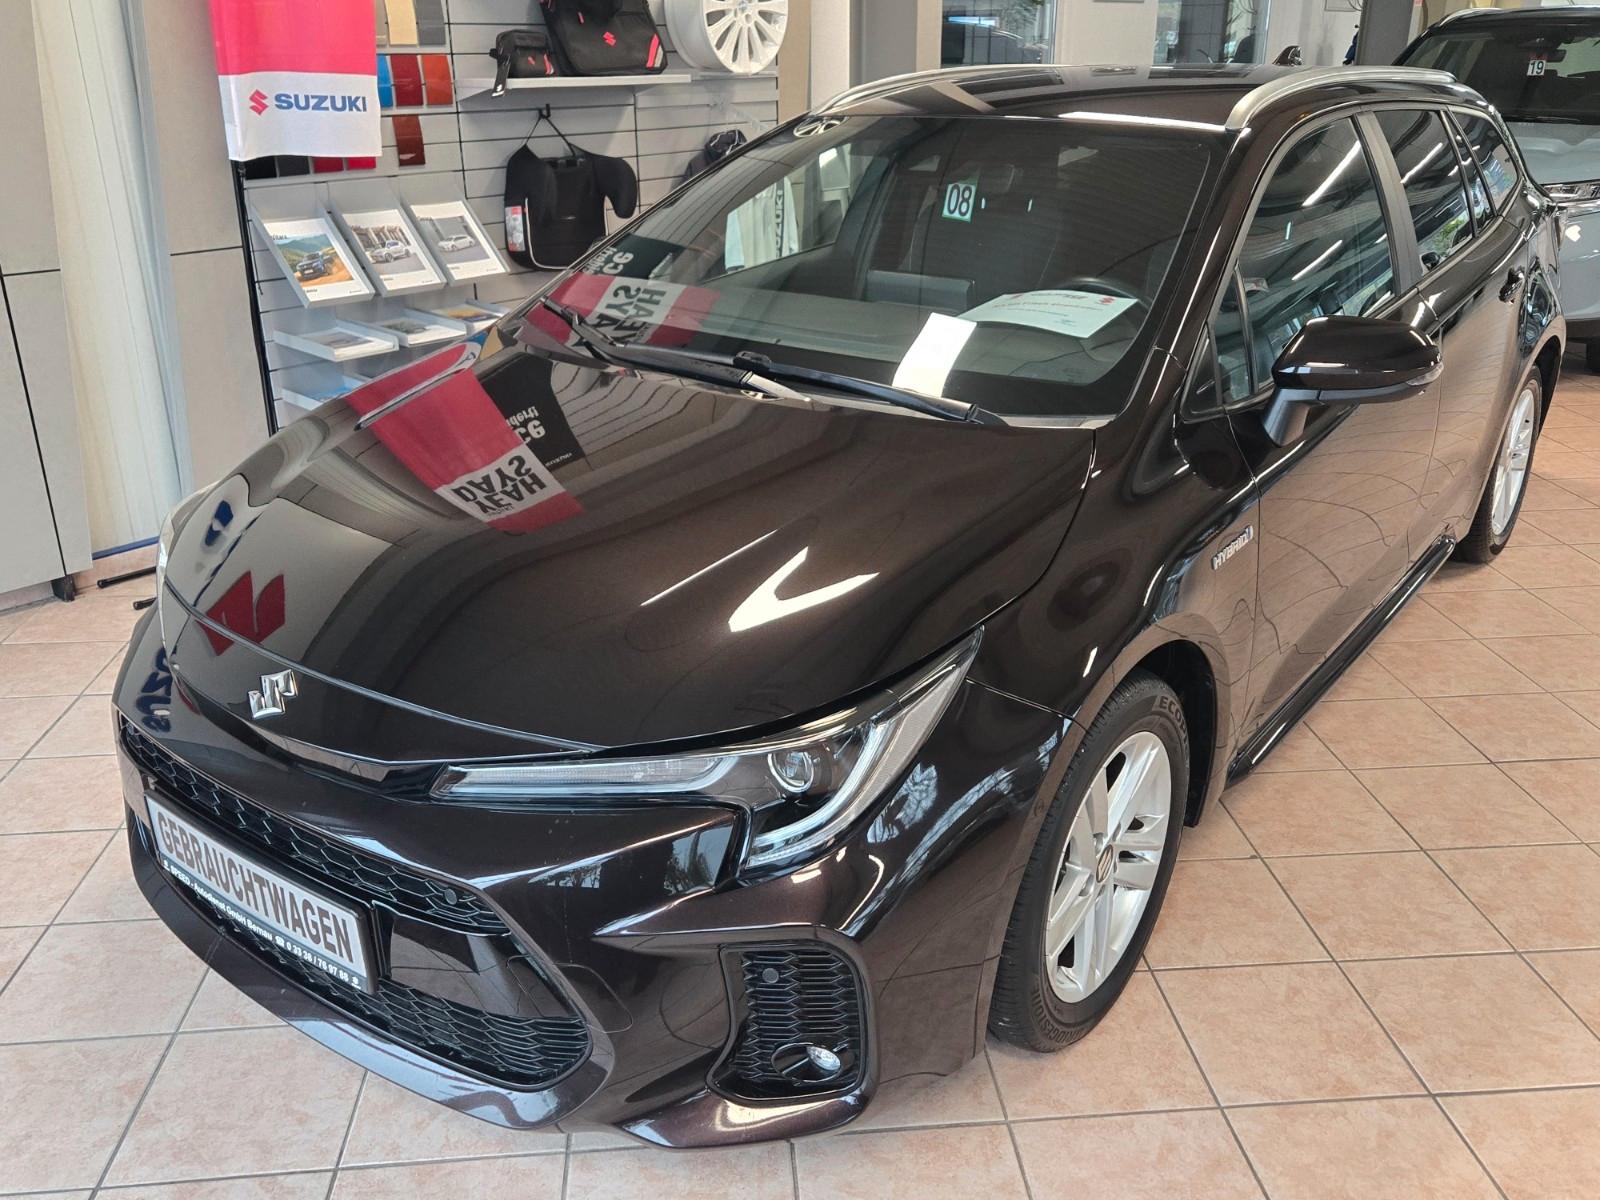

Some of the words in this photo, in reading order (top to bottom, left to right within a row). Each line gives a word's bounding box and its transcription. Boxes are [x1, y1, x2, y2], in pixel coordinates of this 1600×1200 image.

[1530, 61, 1544, 75] 19
[274, 93, 367, 112] SUZUKI
[947, 184, 972, 216] 08
[1213, 532, 1250, 570] HYBRID
[157, 811, 354, 964] GEBRAUCHTWAGEN
[246, 918, 273, 942] Bernau
